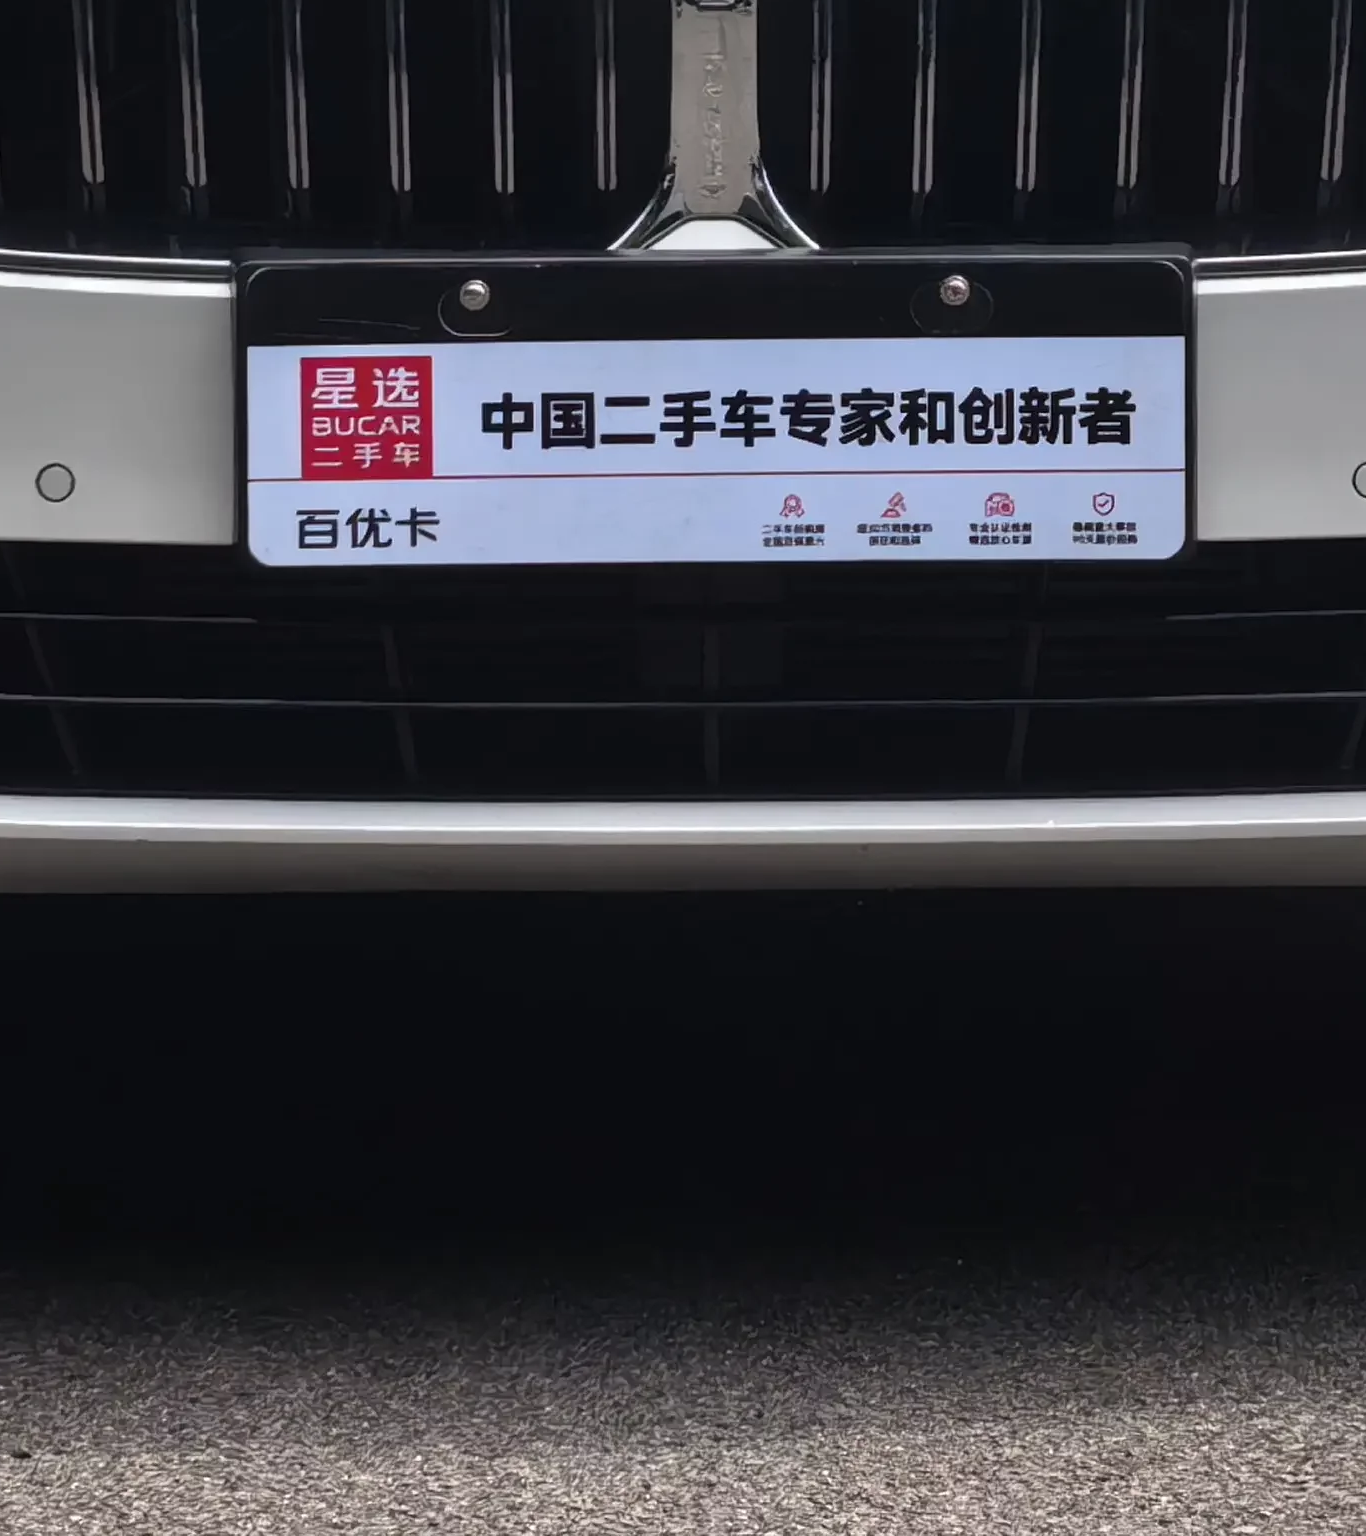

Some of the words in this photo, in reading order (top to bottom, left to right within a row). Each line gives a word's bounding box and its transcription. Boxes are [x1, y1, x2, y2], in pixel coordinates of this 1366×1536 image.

[310, 367, 420, 409] 星选
[311, 415, 421, 437] BUCAR
[481, 386, 1137, 450] 中国二手车专家和创新者
[310, 441, 421, 469] 二手车
[295, 506, 441, 550] 百优卡
